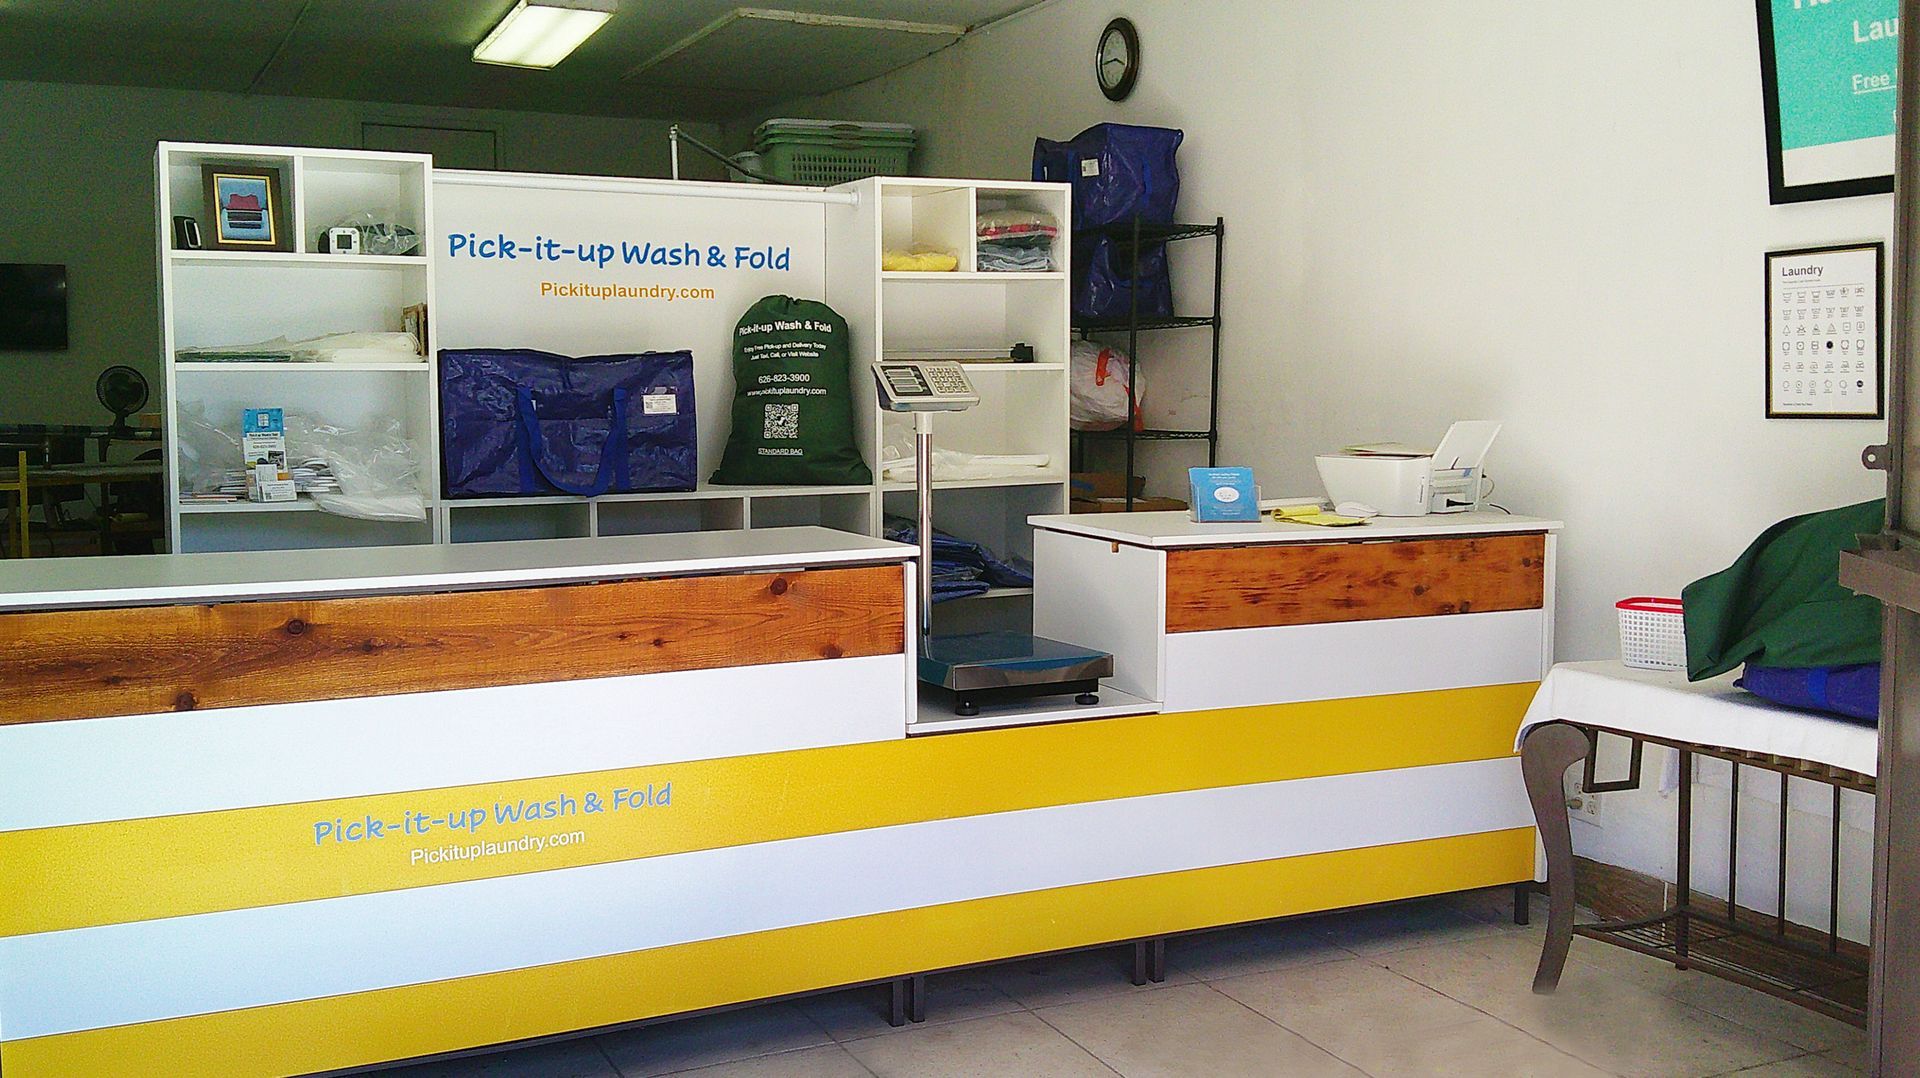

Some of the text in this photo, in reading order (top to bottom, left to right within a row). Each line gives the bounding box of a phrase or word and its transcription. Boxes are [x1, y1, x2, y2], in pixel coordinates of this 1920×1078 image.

[1852, 73, 1890, 91] Free
[448, 233, 791, 271] Pick-it-up Wash & Fold
[1781, 264, 1824, 277] Laundry
[541, 281, 715, 301] Pickituplaundry.com
[739, 320, 832, 336] Pick-it-up Wash & Fold
[758, 373, 810, 384] 626-823-3900
[312, 782, 673, 845] Pick-it-up Wash & Fold
[410, 829, 586, 866] Pickituplaundry.com
